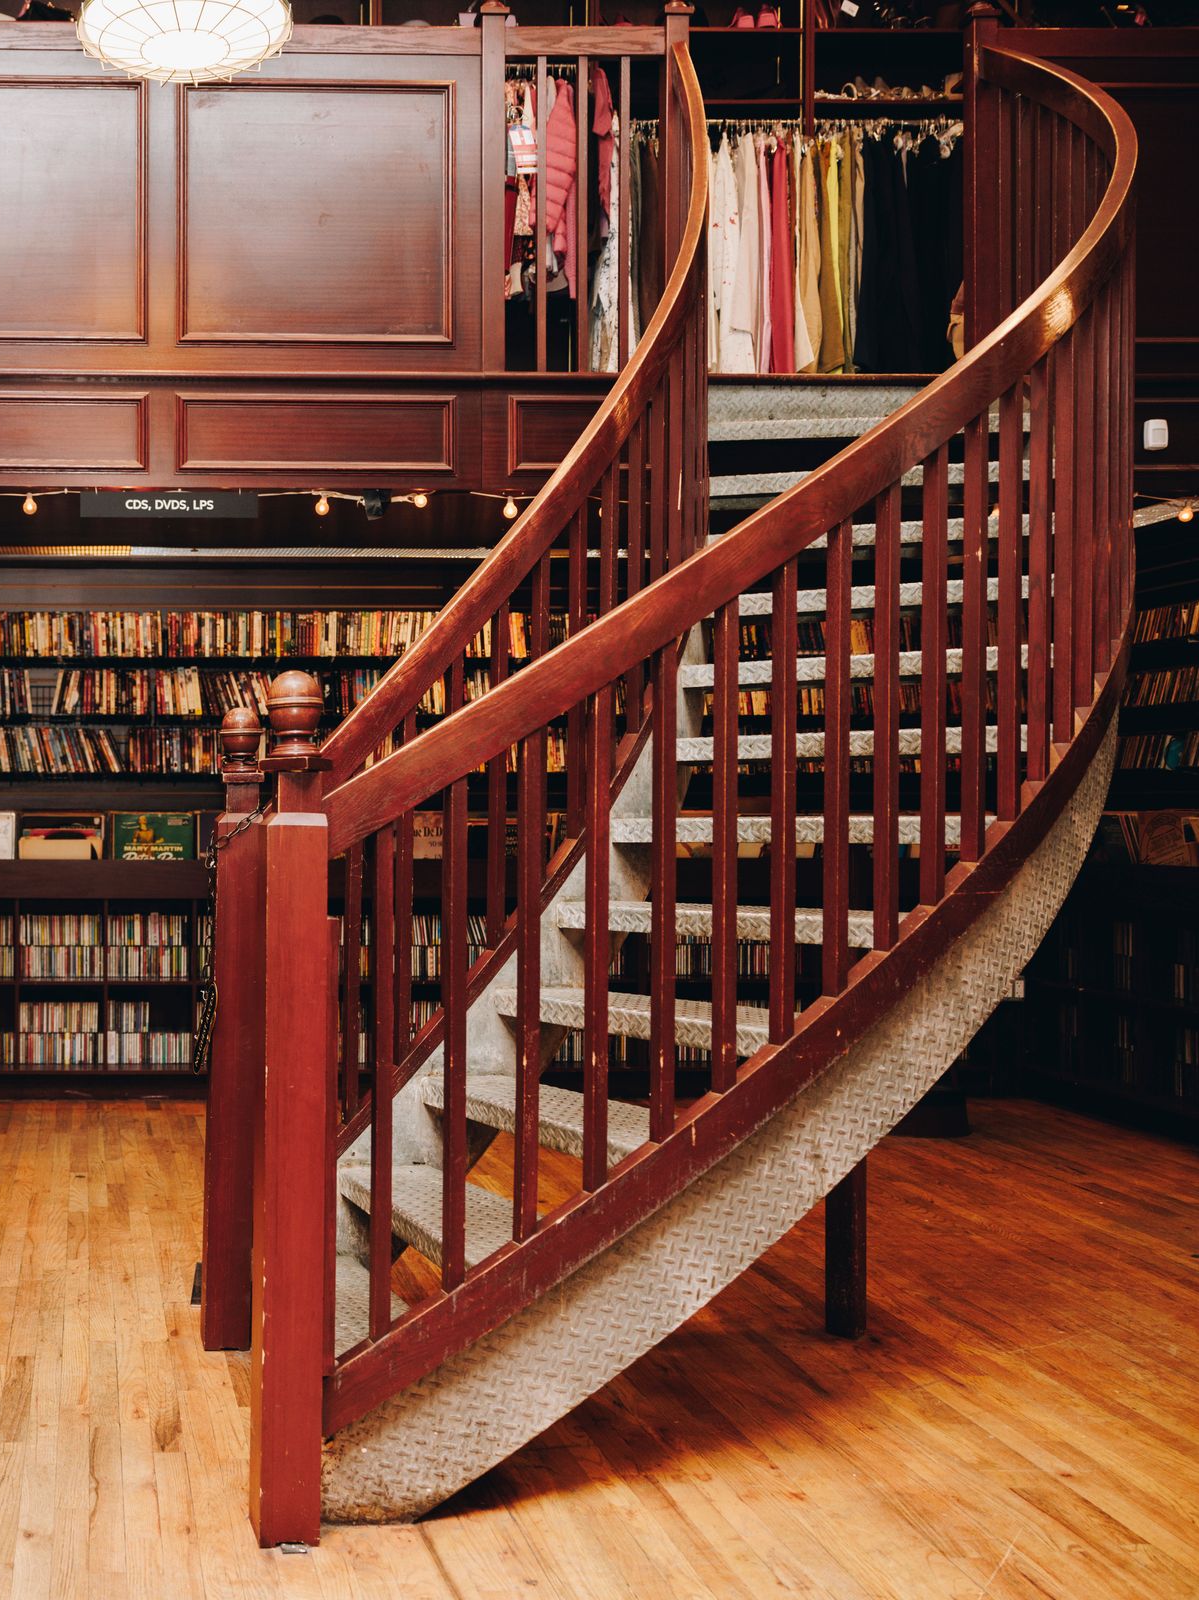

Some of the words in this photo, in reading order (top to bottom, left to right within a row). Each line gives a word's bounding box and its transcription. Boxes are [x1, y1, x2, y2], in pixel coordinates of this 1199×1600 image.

[125, 499, 152, 511] CDS,
[155, 499, 190, 511] DVDS,
[193, 500, 214, 510] LPS
